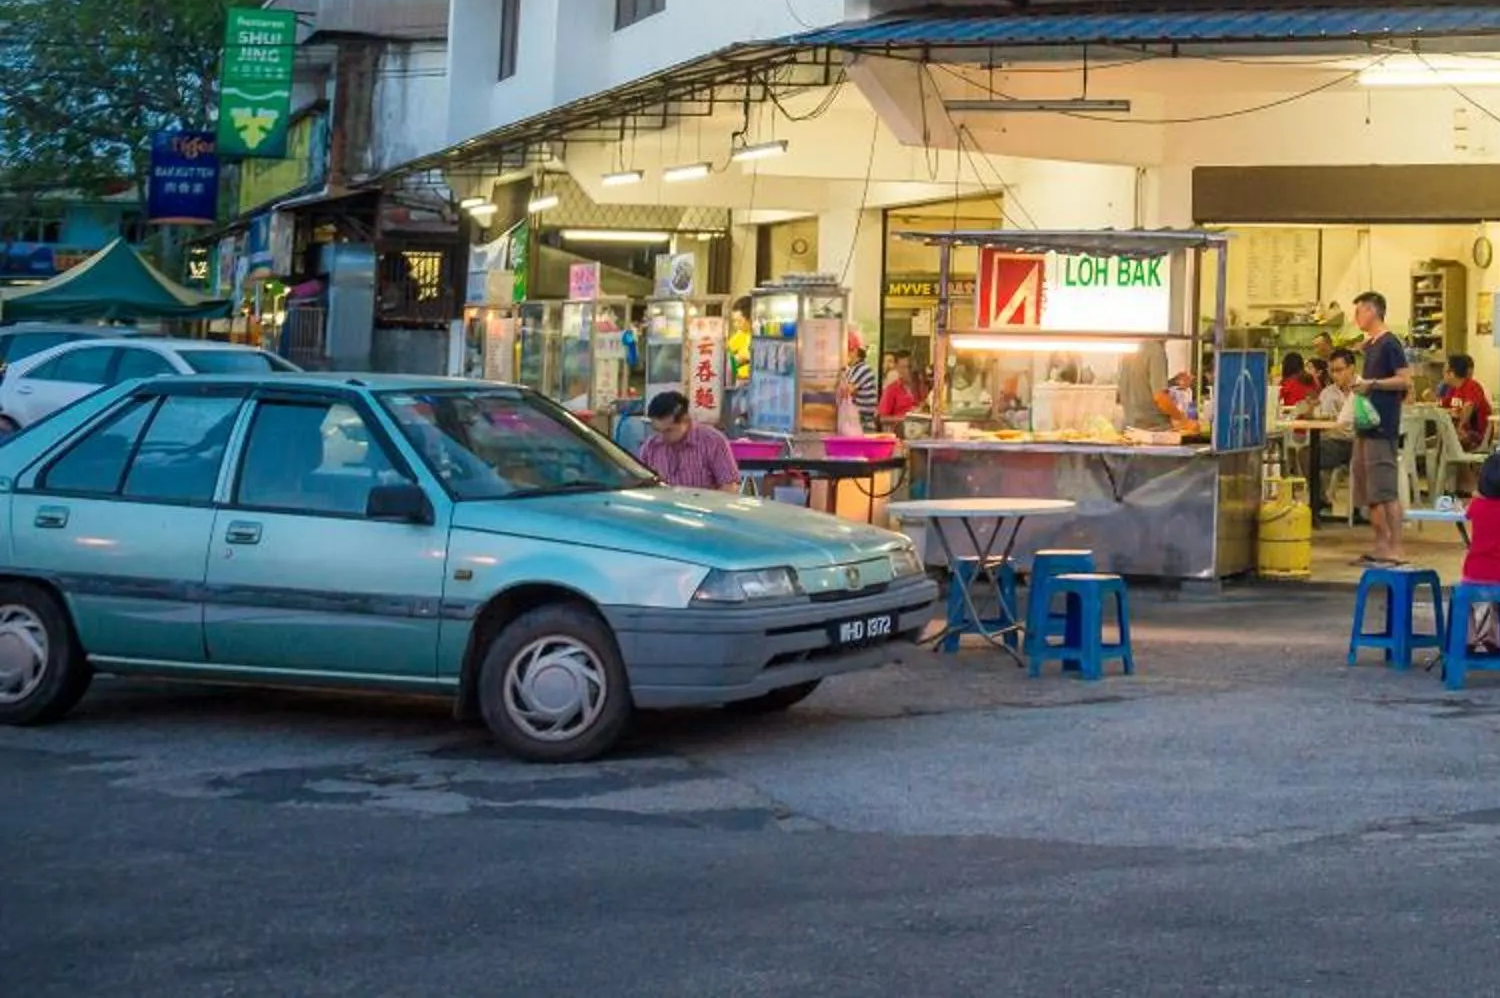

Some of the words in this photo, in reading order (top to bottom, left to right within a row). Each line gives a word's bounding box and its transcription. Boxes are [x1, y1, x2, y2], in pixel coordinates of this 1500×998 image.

[236, 48, 280, 63] JING
[1065, 256, 1108, 287] LOH
[1117, 255, 1162, 287] BAK
[889, 283, 931, 295] MYVE
